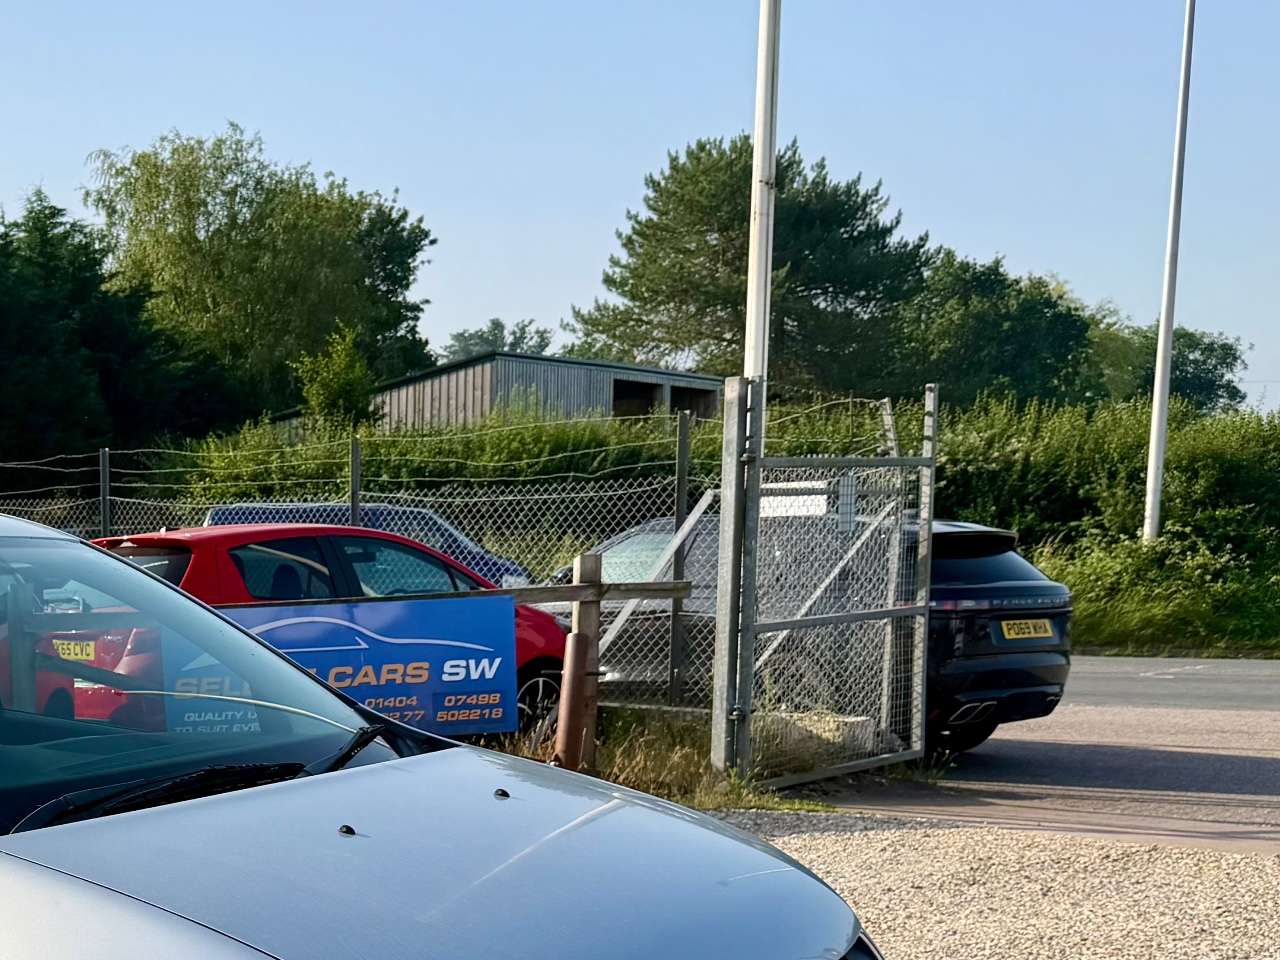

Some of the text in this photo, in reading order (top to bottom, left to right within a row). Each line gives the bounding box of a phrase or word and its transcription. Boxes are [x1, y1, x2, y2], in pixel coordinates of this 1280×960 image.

[328, 661, 430, 688] CARS
[441, 657, 502, 682] SW
[364, 696, 418, 709] 01404
[184, 711, 244, 721] QUALITY
